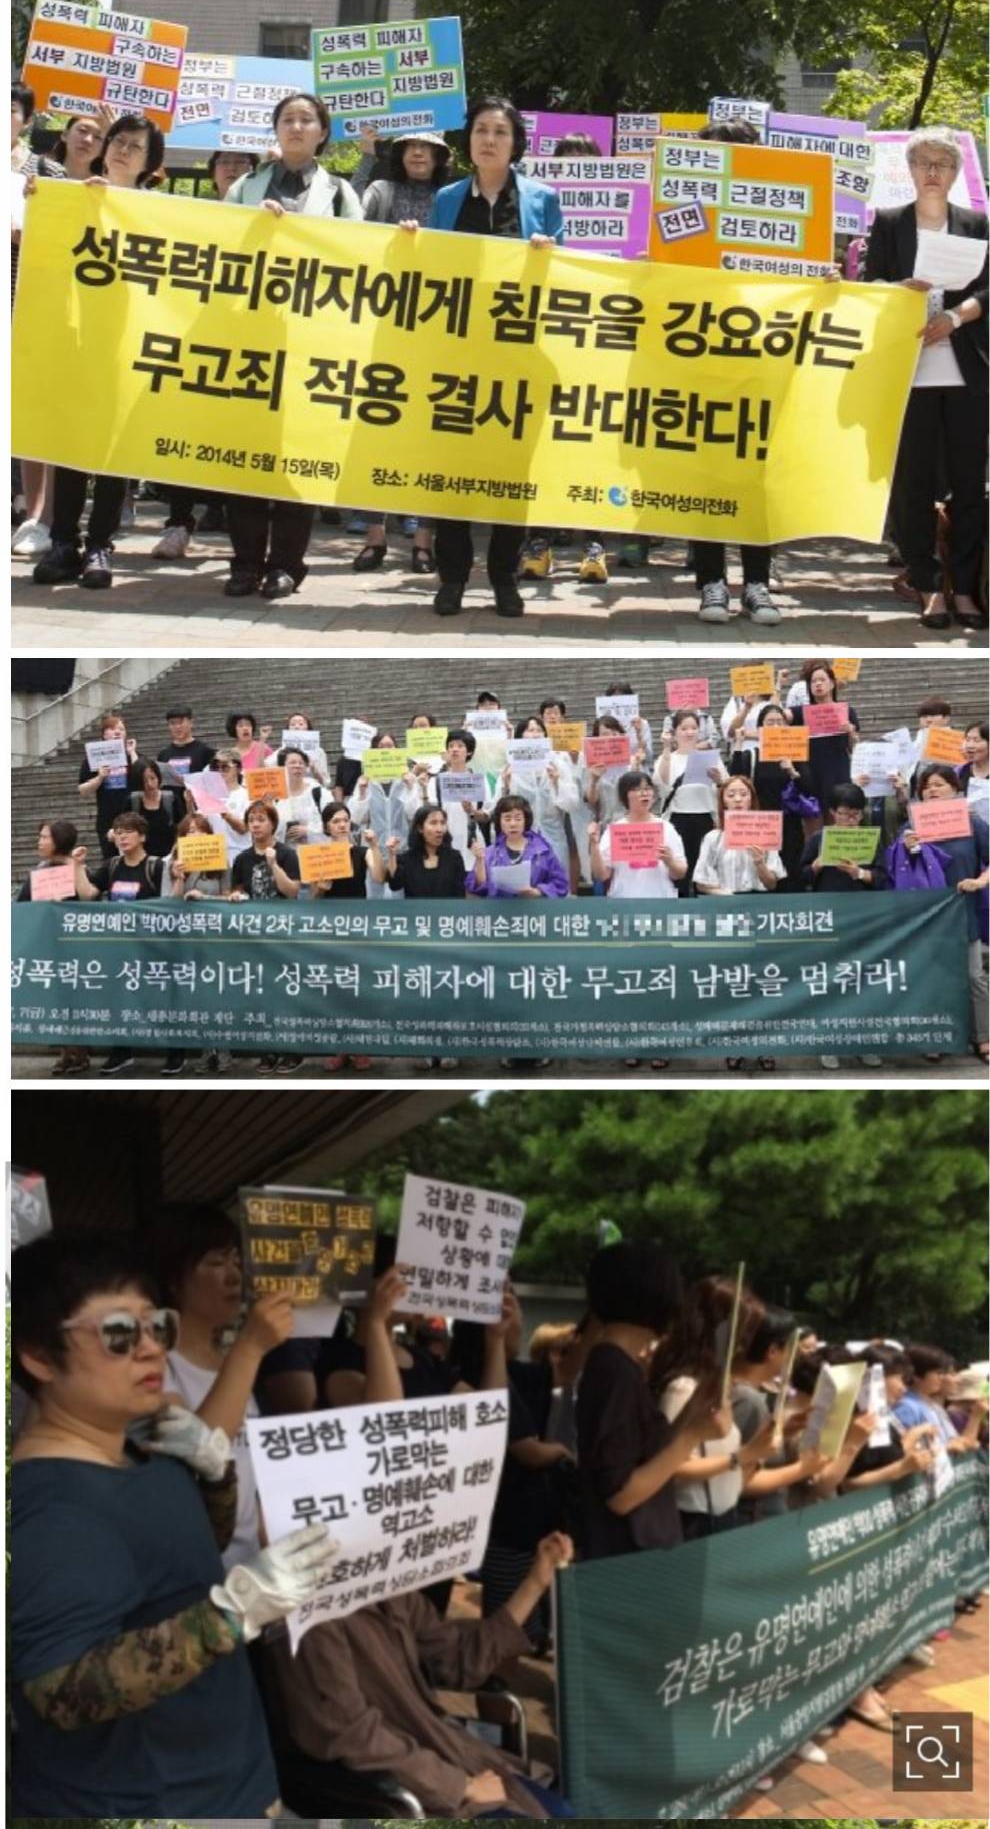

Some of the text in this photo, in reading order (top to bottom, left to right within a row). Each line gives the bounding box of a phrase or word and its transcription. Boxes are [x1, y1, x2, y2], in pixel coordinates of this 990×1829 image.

[40, 1, 145, 35] 성폭력 피해자
[116, 39, 176, 64] 구속하는
[321, 27, 422, 52] 성폭력 피해자
[32, 45, 137, 79] 서부 지방법원
[184, 59, 228, 74] 정부는
[321, 50, 429, 80] 구속하는 서부
[107, 83, 169, 108] 규탄한다
[180, 80, 226, 98] 성폭력
[393, 72, 454, 93] 지방법원
[181, 103, 210, 121] 전면
[324, 91, 384, 111] 규탄한다
[715, 103, 763, 123] 정부는
[619, 116, 657, 130] 정부는
[666, 147, 720, 171] 정부는
[771, 133, 871, 161] 피해자에 대한
[531, 162, 563, 180] 서부
[566, 162, 647, 180] 지방법원은
[836, 170, 869, 194] 조항
[662, 179, 805, 211] 성폭력 근절정책
[663, 209, 702, 236] 전면
[720, 217, 797, 244] 검토하라
[72, 226, 864, 370] 성폭력피해자에게 침묵을 강요하는
[132, 331, 771, 462] 무고죄 적용 결사 반대한다!
[155, 437, 341, 481] 일시: 2014년 5월 15일(목)
[372, 468, 538, 502] 장소: 서울서부지방법원
[567, 484, 739, 518] 주최: 한국여성의전화
[62, 912, 137, 934] 유명연예인
[227, 913, 263, 935] 사건
[265, 914, 295, 935] 2차
[299, 914, 369, 938] 고소인의
[373, 916, 409, 938] 무고
[416, 915, 432, 938] 및
[437, 915, 547, 938] 명예훼손죄에
[554, 914, 591, 938] 대한
[756, 910, 835, 936] 기자회견
[11, 957, 908, 1001] 성폭력은 성폭력이다! 성폭력 피해자에 대한 무고죄 남발을 멈춰라!
[425, 1184, 477, 1216] 검찰은
[416, 1211, 494, 1244] 저항할 수
[440, 1244, 491, 1269] 상황에
[259, 1400, 509, 1461] 정당한 성폭력피해 호소
[366, 1439, 449, 1478] 가로막는
[290, 1457, 495, 1527] 무고 명예훼손에 대한
[380, 1503, 436, 1538] 역고소
[397, 1516, 479, 1564] 처벌하라!
[657, 1632, 743, 1708] 검찰은
[747, 1575, 853, 1669] 유명연예인에
[855, 1557, 881, 1603] 의한
[711, 1663, 799, 1740] 가로막는
[802, 1625, 853, 1686] 무고와
